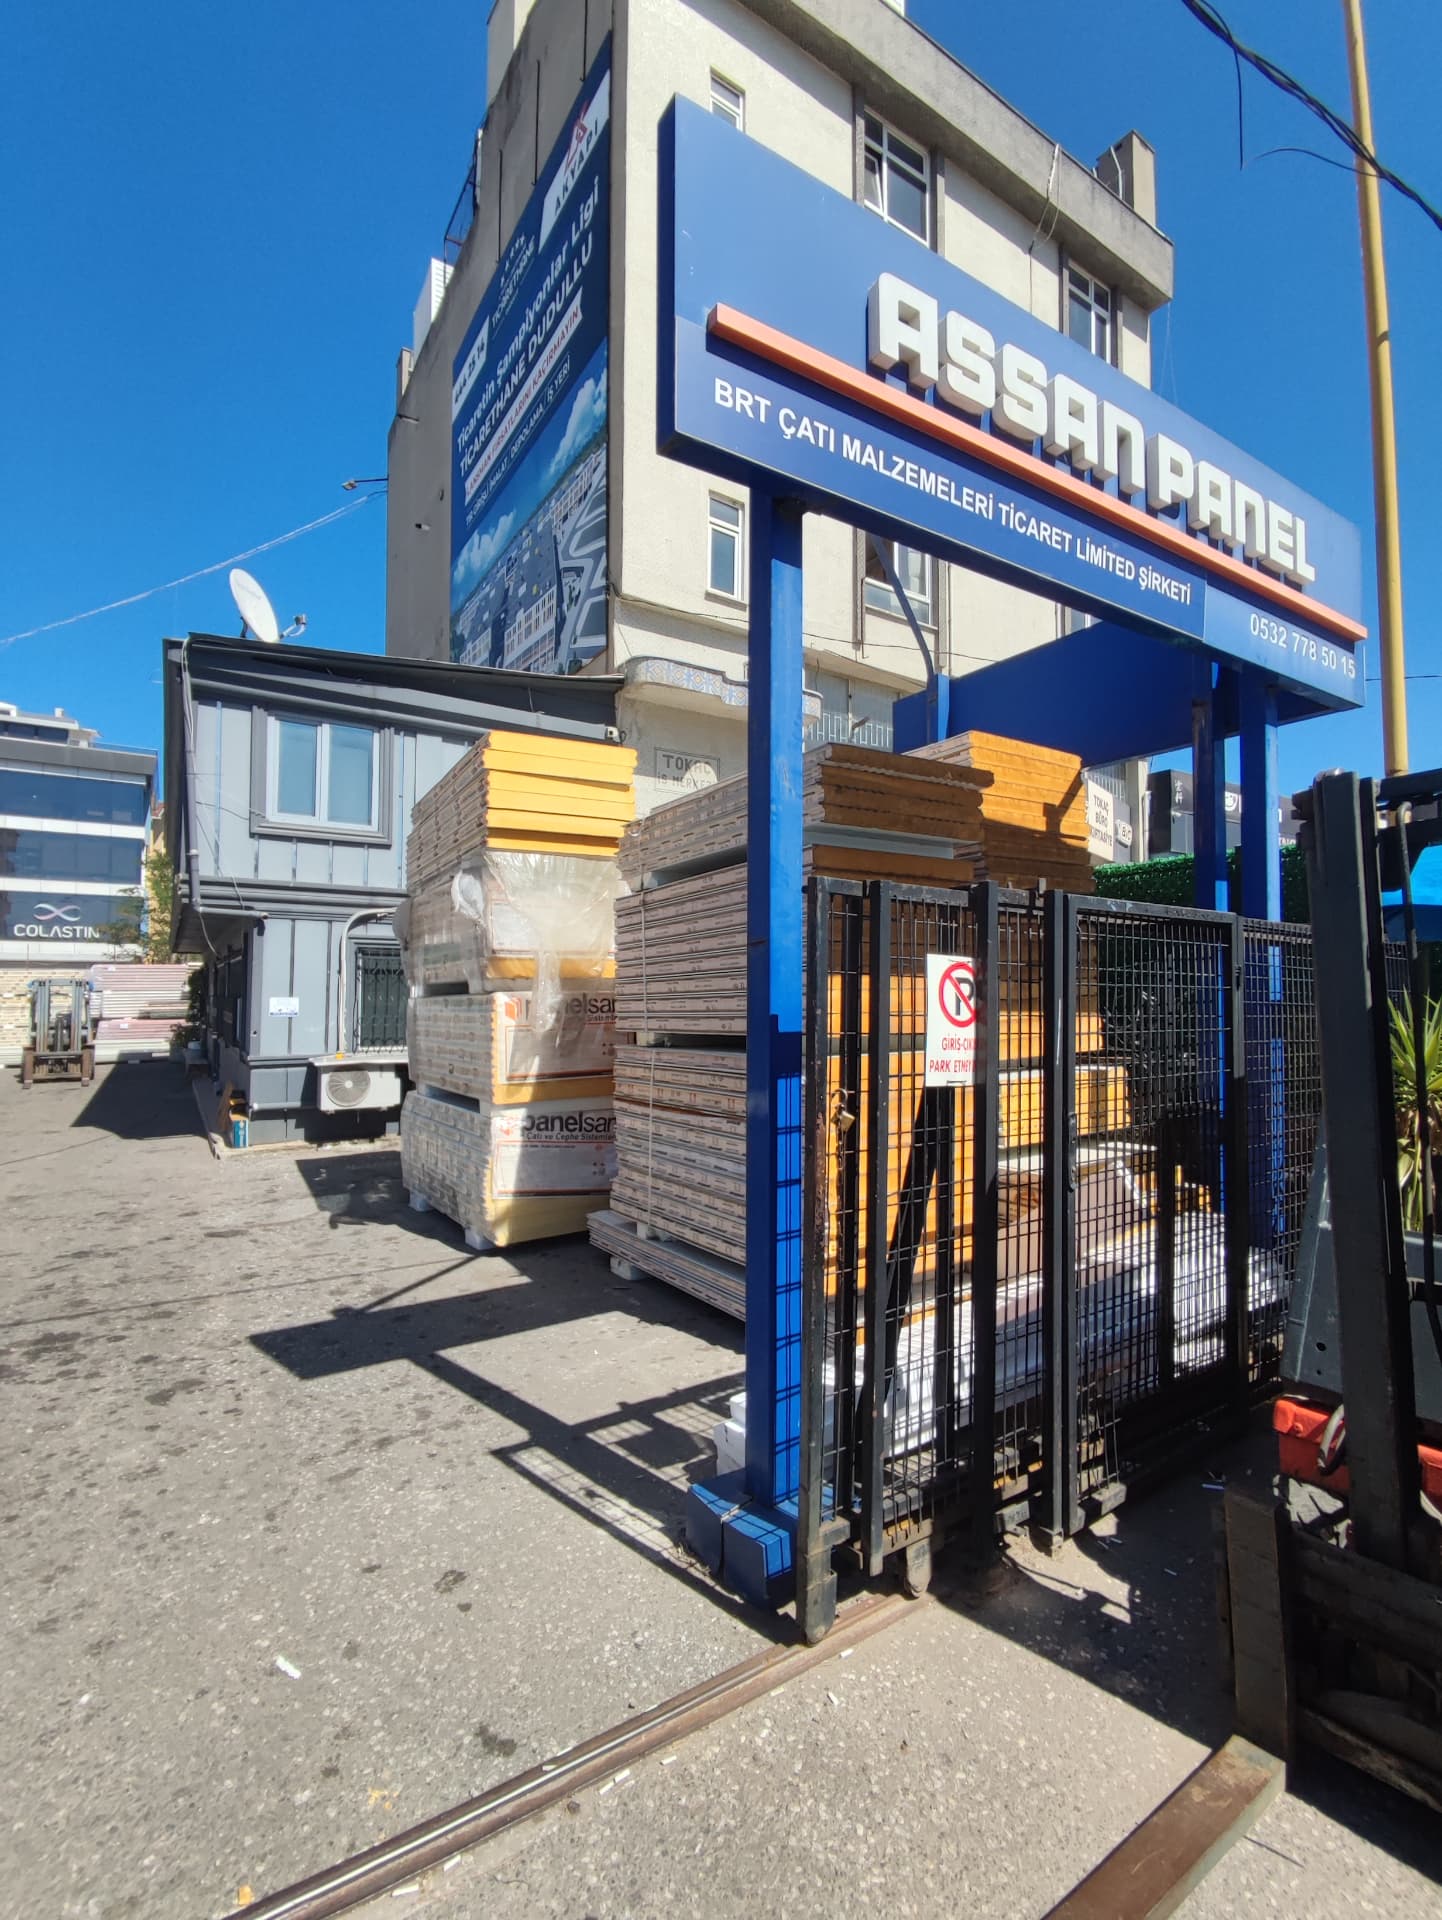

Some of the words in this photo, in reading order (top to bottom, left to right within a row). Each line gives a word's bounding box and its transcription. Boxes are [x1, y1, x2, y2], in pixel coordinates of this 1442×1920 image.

[555, 118, 598, 215] AKYAPI
[457, 379, 495, 453] Ticaretin
[496, 242, 567, 386] Şampiyonlar
[571, 174, 598, 246] Ligi
[459, 355, 526, 478] TİCARETHANE
[528, 231, 592, 361] DUDULLU
[714, 378, 771, 423] BRT
[779, 407, 835, 452] ÇATI
[842, 434, 994, 520] MALZEMELERİ
[998, 502, 1072, 553] TİCARET
[1076, 536, 1135, 580] LİMİTED
[1139, 564, 1191, 605] ŞİRKETİ
[868, 272, 1145, 494] ASSAN
[1147, 433, 1316, 581] PANEL
[1250, 613, 1287, 648] 0532
[1292, 635, 1317, 662] 778
[1321, 648, 1337, 671] 50
[1341, 656, 1356, 679] 15
[14, 924, 100, 939] COLASTIN
[929, 1059, 951, 1073] PARK
